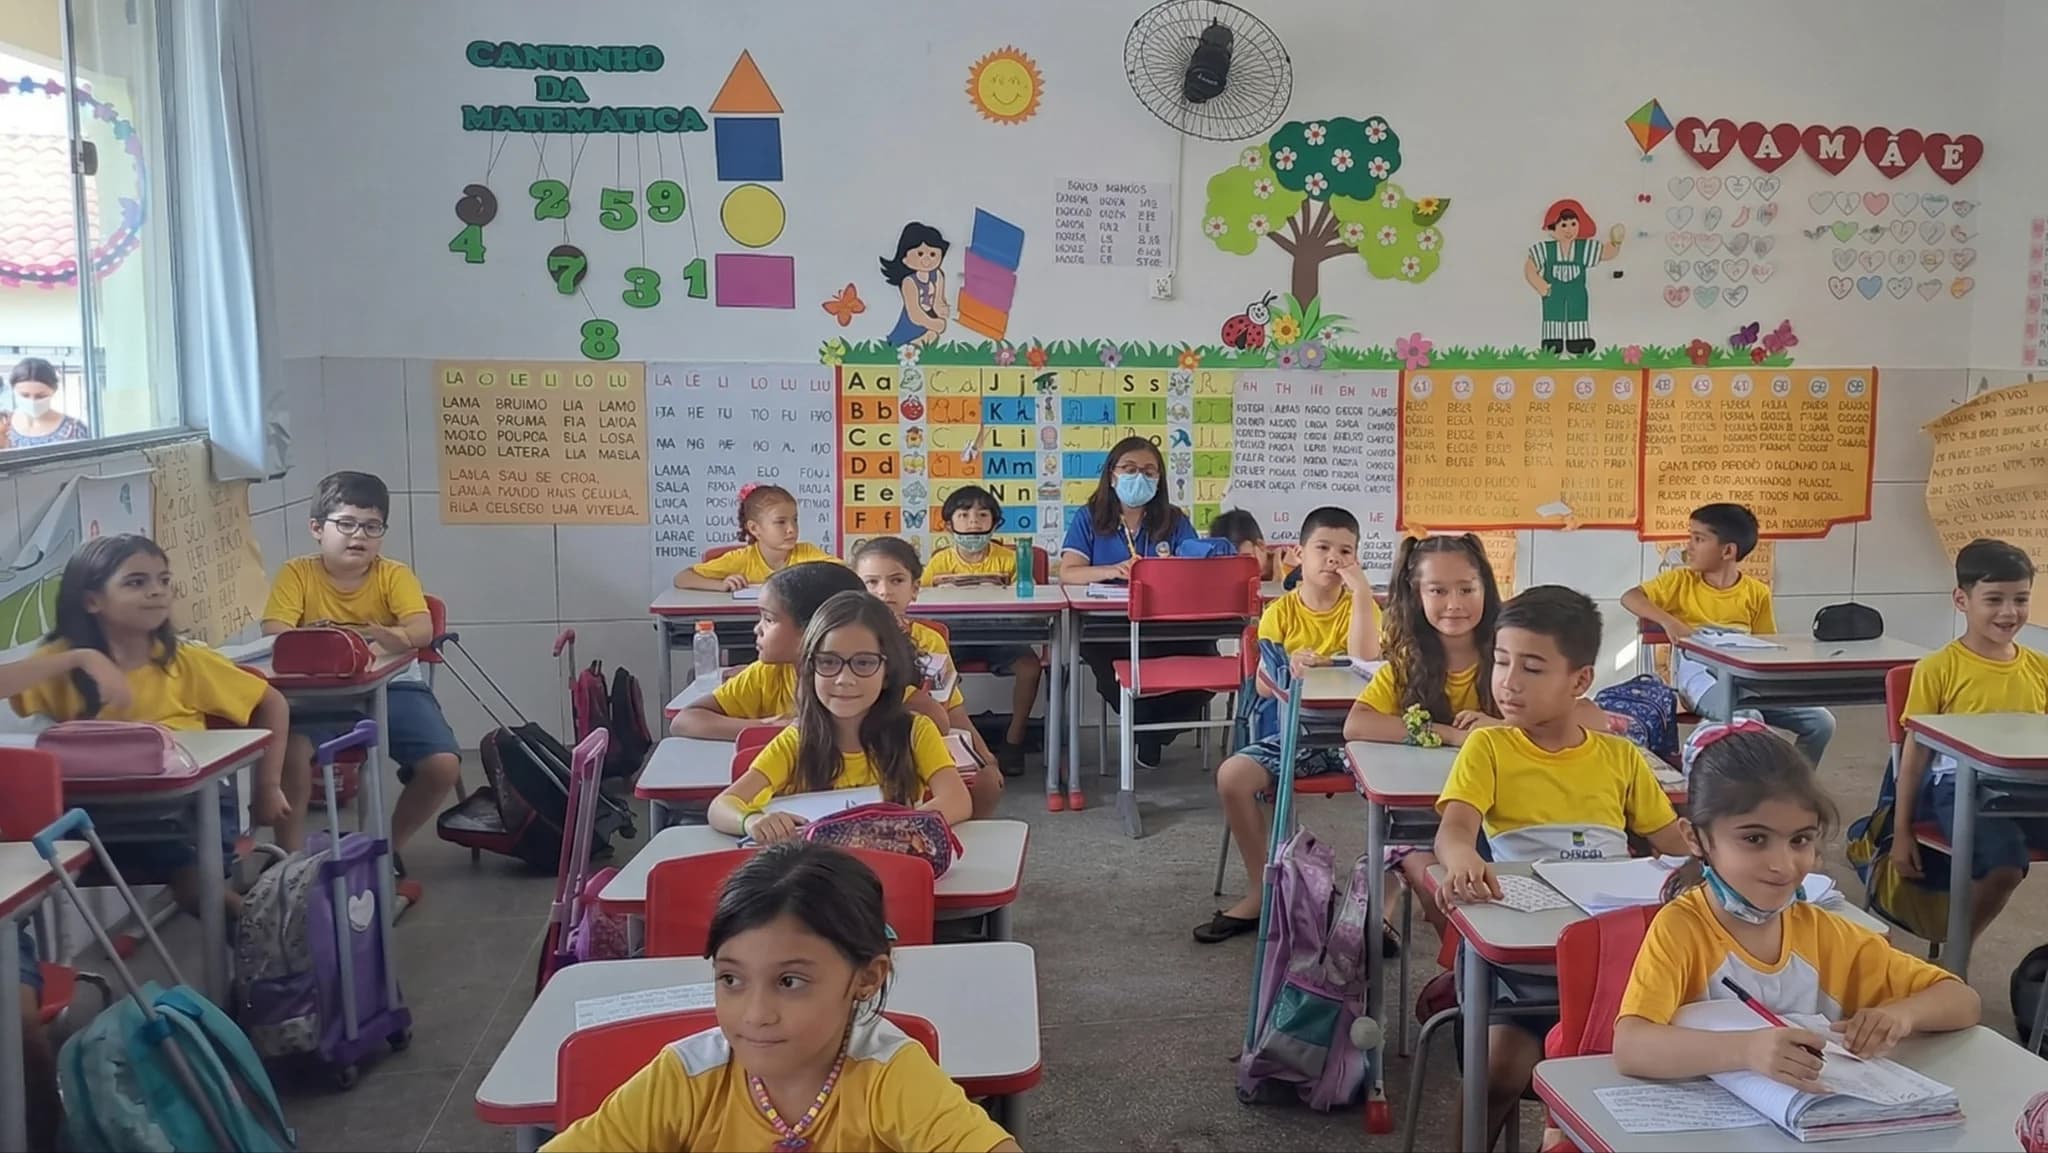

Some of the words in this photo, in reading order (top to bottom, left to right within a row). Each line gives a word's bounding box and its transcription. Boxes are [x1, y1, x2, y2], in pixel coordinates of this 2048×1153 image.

[466, 41, 664, 72] CANTINHO
[535, 76, 590, 102] DA
[461, 105, 708, 133] MATEMATICA
[529, 179, 571, 220] 2
[599, 188, 638, 231] 5
[646, 180, 685, 222] 9
[449, 224, 486, 263] 4
[548, 255, 586, 294] 7
[622, 267, 661, 308] 3
[683, 258, 708, 299] 1
[580, 318, 620, 360] 8
[446, 371, 464, 384] LA
[510, 373, 528, 386] LE
[575, 374, 593, 387] LO
[609, 375, 627, 388] LU
[655, 374, 672, 386] LA
[685, 374, 700, 387] LE
[752, 377, 768, 390] LO
[781, 379, 797, 391] LU
[1123, 374, 1135, 392] S
[442, 397, 480, 409] LAMA
[599, 400, 636, 412] LAMO
[655, 464, 690, 476] LAMA
[757, 466, 780, 478] ELO
[656, 481, 690, 493] SALA
